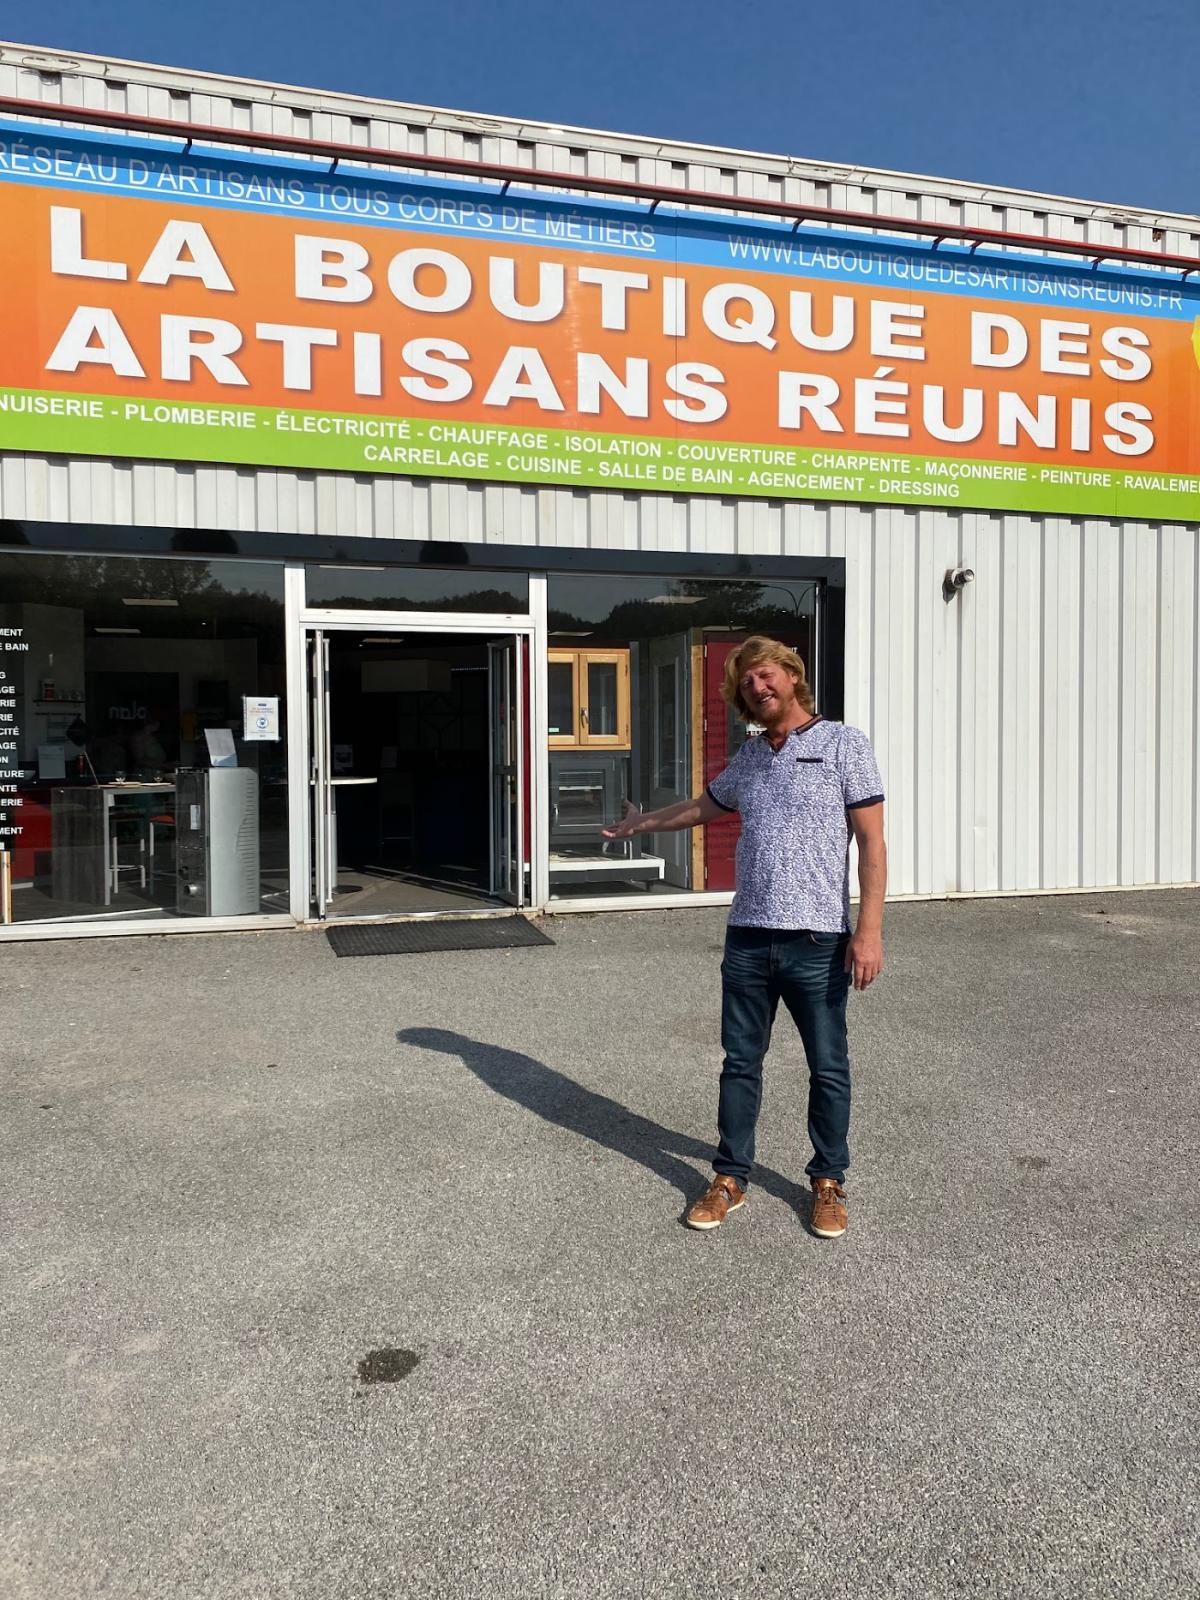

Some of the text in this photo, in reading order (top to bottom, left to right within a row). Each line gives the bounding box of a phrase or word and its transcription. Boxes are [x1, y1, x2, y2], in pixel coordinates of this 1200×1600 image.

[129, 158, 305, 206] D'ARTISANS
[314, 182, 390, 216] TOUS
[399, 194, 493, 228] CORPS
[502, 207, 537, 234] DE
[545, 210, 656, 249] MÉTIERS
[50, 205, 1153, 382] LA BOUTIQUE DES
[728, 235, 1183, 311] WWW.LABOUTIQUEDESARTISANSREUNIS.FR
[44, 305, 1155, 456] ARTISANS RÉUNIS
[125, 403, 256, 428] PLOMBERIE
[276, 411, 411, 440] ÉLECTRICITÉ
[428, 425, 548, 450] CHAUFFAGE
[565, 436, 662, 458] ISOLATION
[677, 444, 796, 466] COUVERTURE
[811, 453, 910, 474] CHARPENTE
[924, 461, 1027, 482] MAÇONNERIE
[1040, 469, 1111, 487] PEINTURE
[1124, 475, 1200, 493] RAVALEME
[364, 444, 489, 469] CARRELAGE
[507, 454, 582, 475] CUISINE
[598, 461, 657, 480] SALLE
[662, 465, 686, 482] DE
[691, 467, 733, 484] BAIN
[747, 471, 865, 492] AGENCEMENT
[879, 478, 960, 498] DRESSING
[5, 643, 29, 651] BAIN
[1, 798, 24, 807] ERIE
